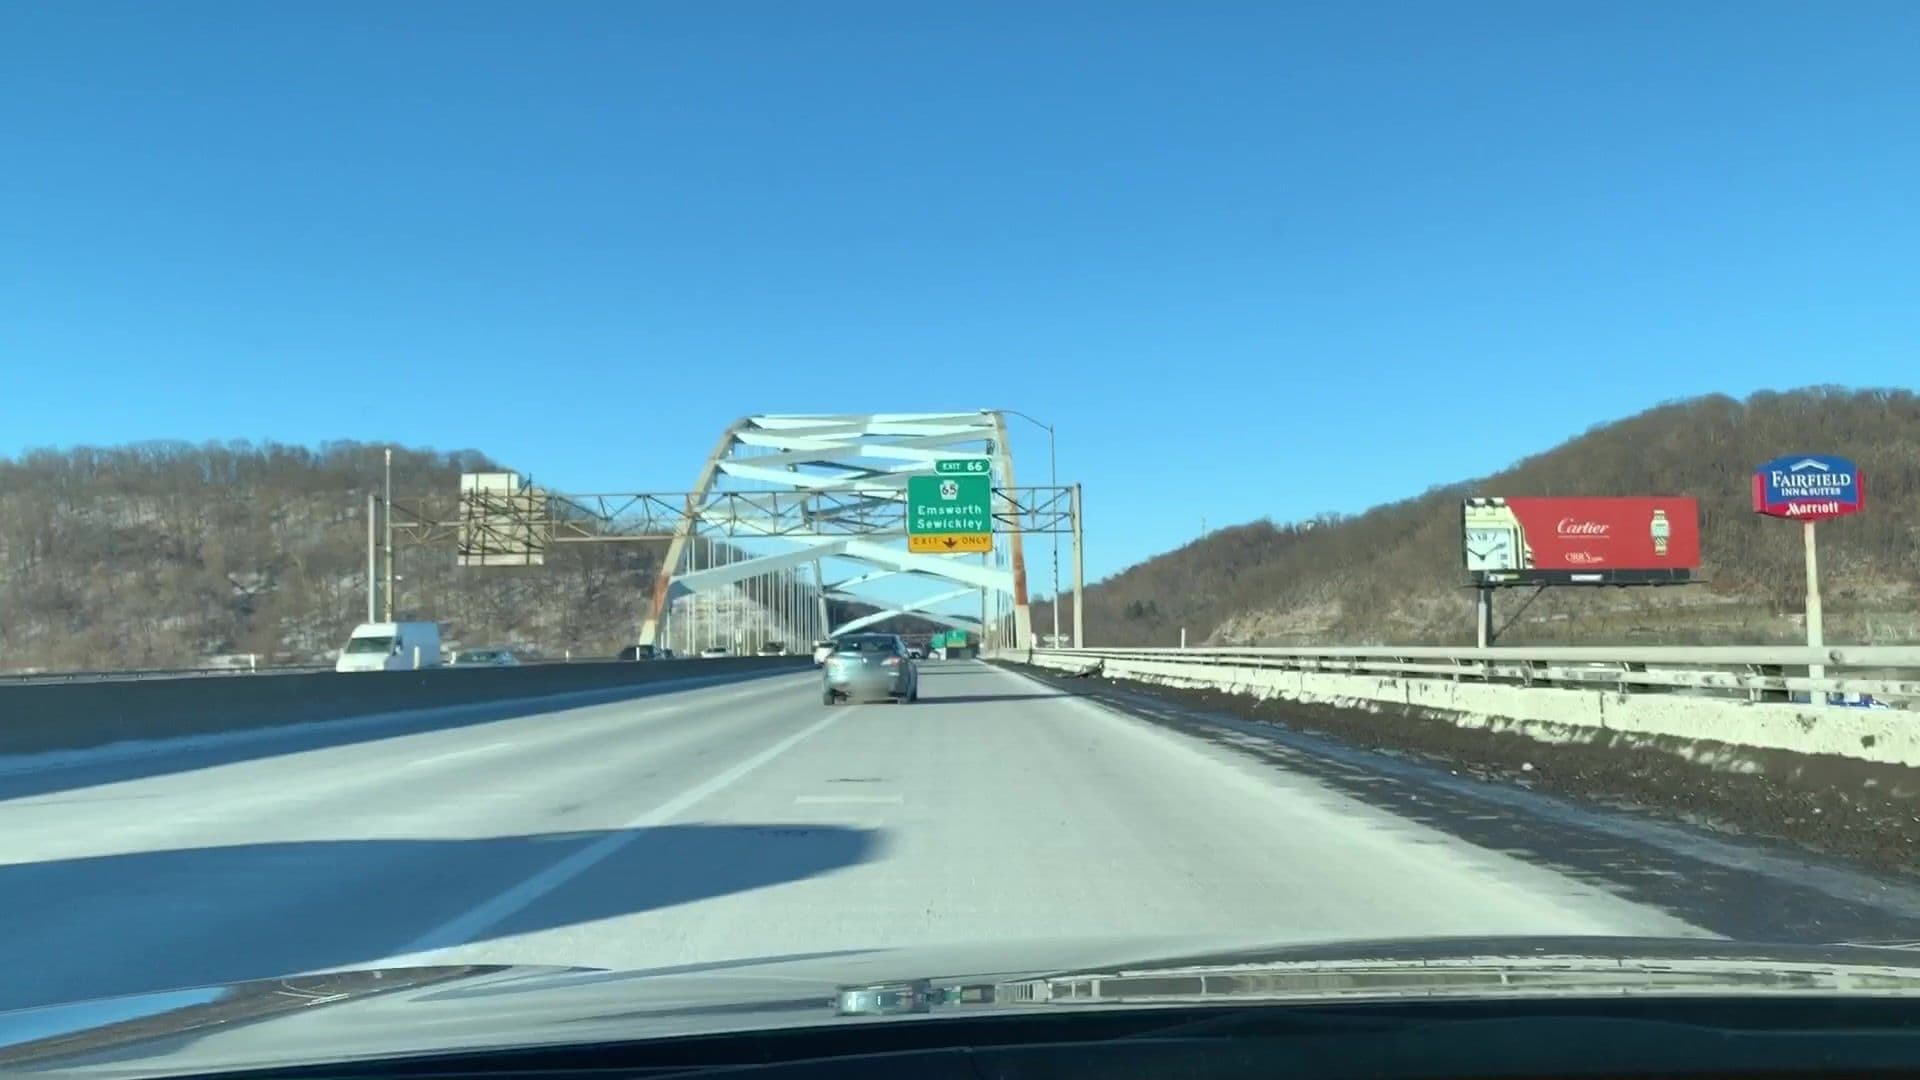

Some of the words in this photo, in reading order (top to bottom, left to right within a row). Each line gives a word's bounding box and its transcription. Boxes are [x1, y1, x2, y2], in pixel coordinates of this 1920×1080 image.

[967, 462, 983, 471] 66
[1772, 470, 1851, 488] FAIRFIELD
[942, 483, 957, 495] 65
[1782, 488, 1799, 496] INN
[1800, 488, 1809, 496] &
[1809, 487, 1841, 496] SUITES
[917, 505, 982, 516] Emsworth
[1786, 502, 1839, 516] Marriott
[917, 519, 983, 531] Sewickley
[1557, 518, 1610, 534] Cartier
[913, 537, 938, 545] EXIT
[961, 536, 988, 545] ONLY
